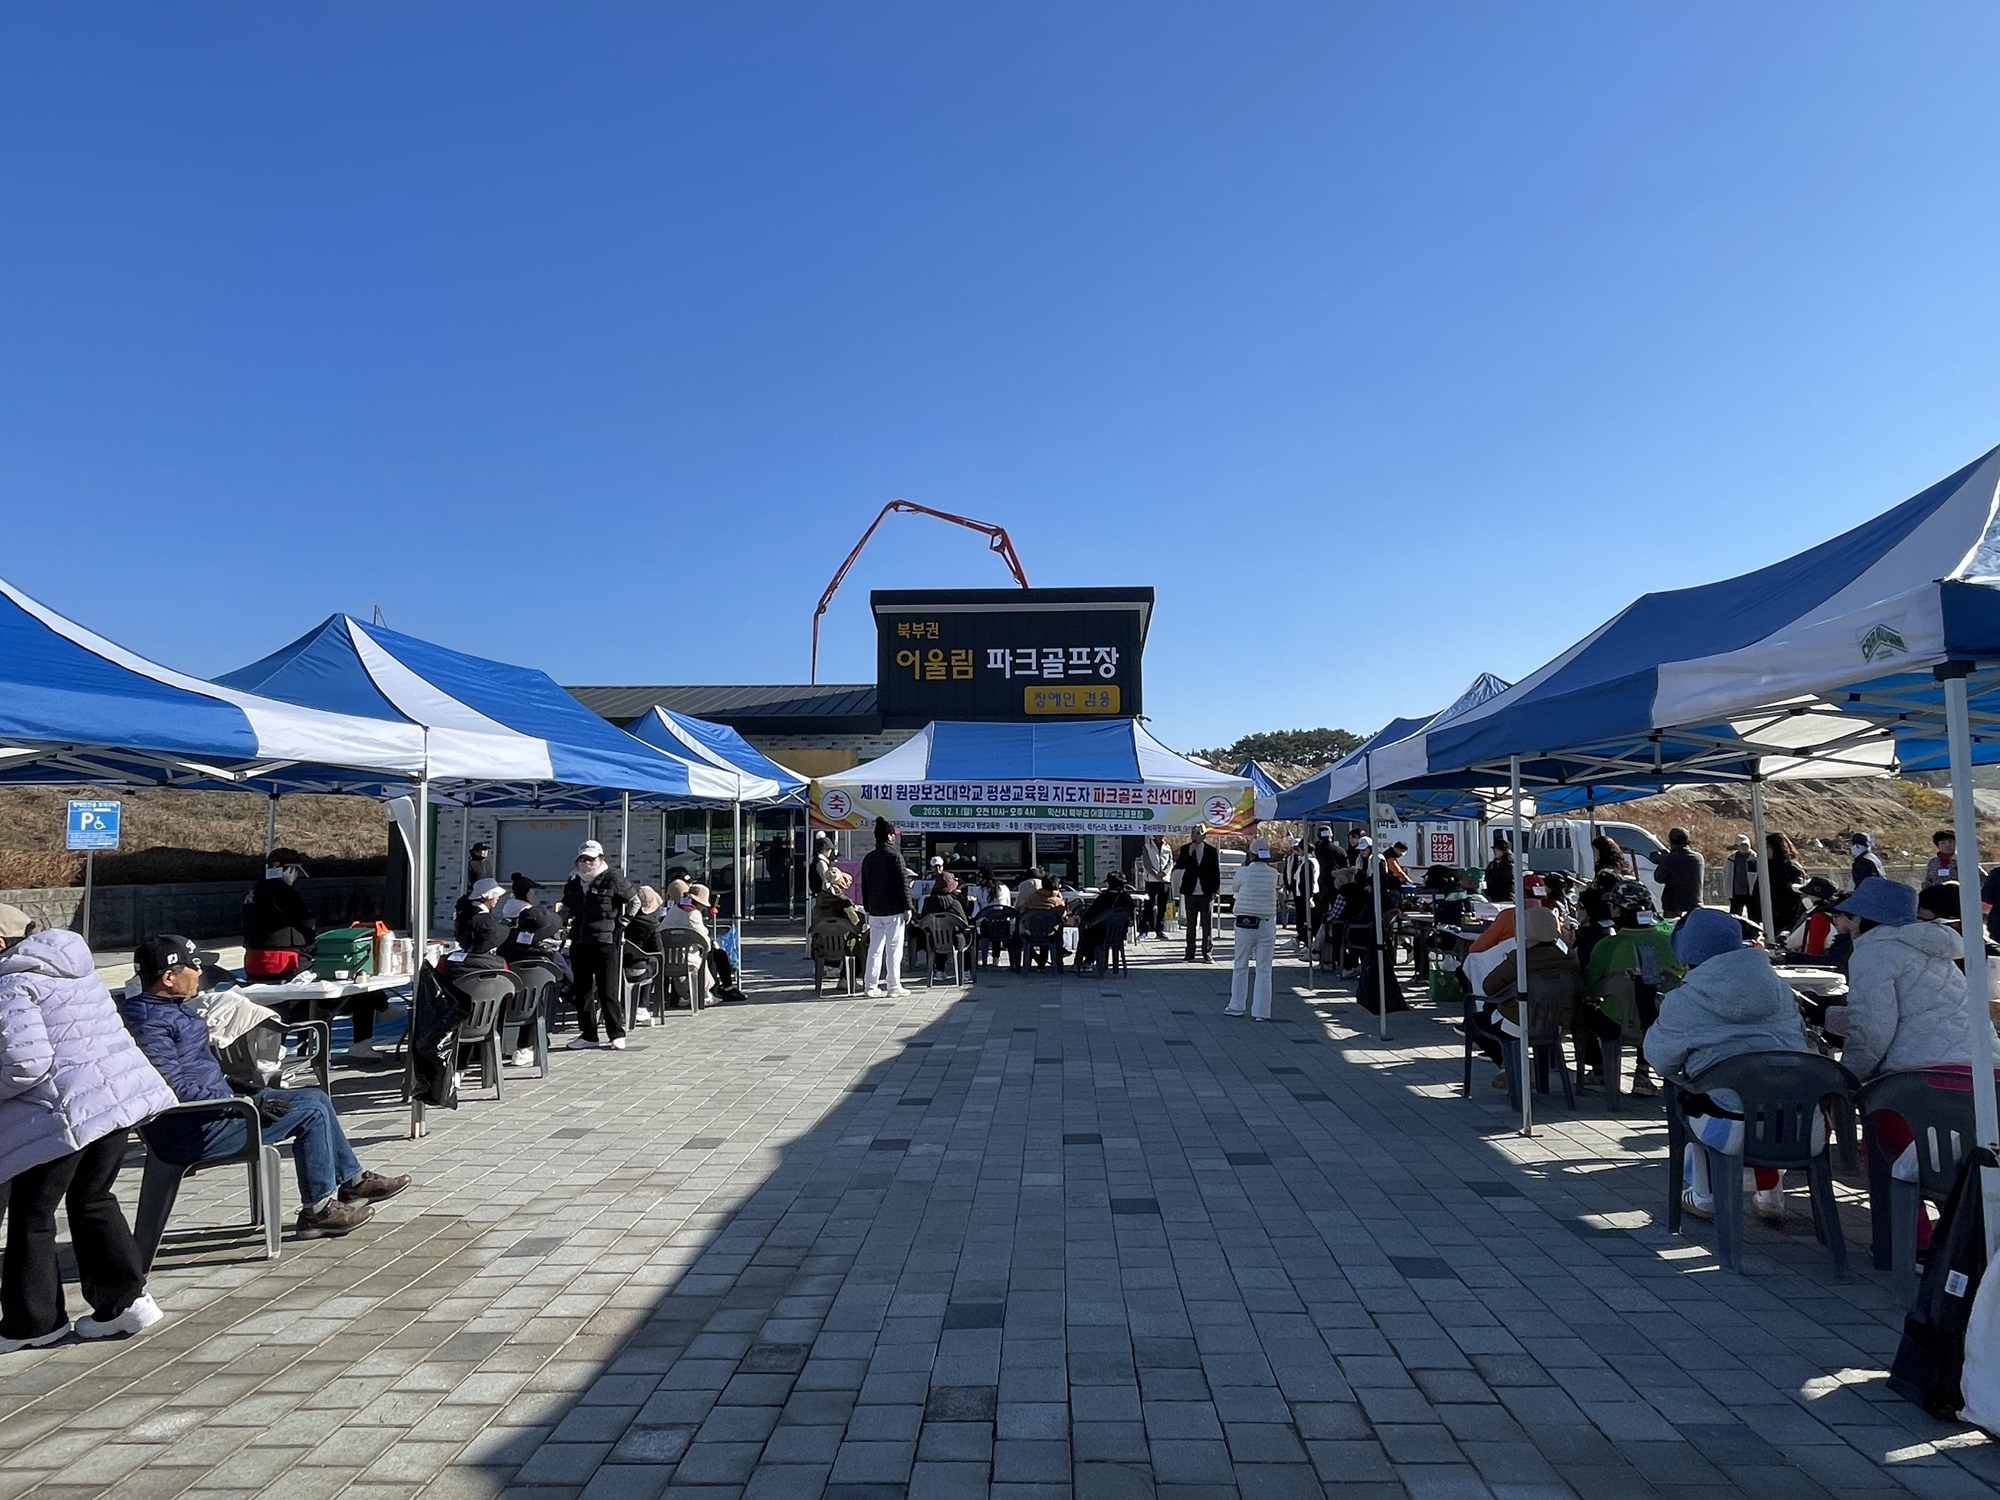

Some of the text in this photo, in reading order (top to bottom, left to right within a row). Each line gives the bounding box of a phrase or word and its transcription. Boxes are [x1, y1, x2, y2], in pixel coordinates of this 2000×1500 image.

[897, 621, 940, 640] 북부권
[896, 646, 1122, 681] 어울림 파크골프장
[1034, 691, 1111, 709] 장애인 겸용
[827, 795, 846, 813] 축
[860, 784, 1197, 806] 제1회 원광보건대학교 평생교육원 지도자 파크골프 친선대회
[976, 807, 989, 816] 오전
[1024, 808, 1036, 817] 4시
[1208, 800, 1228, 820] 축
[81, 812, 94, 831] P
[1432, 834, 1453, 843] 010-
[1432, 843, 1453, 852] 2224
[1432, 852, 1453, 862] 3387
